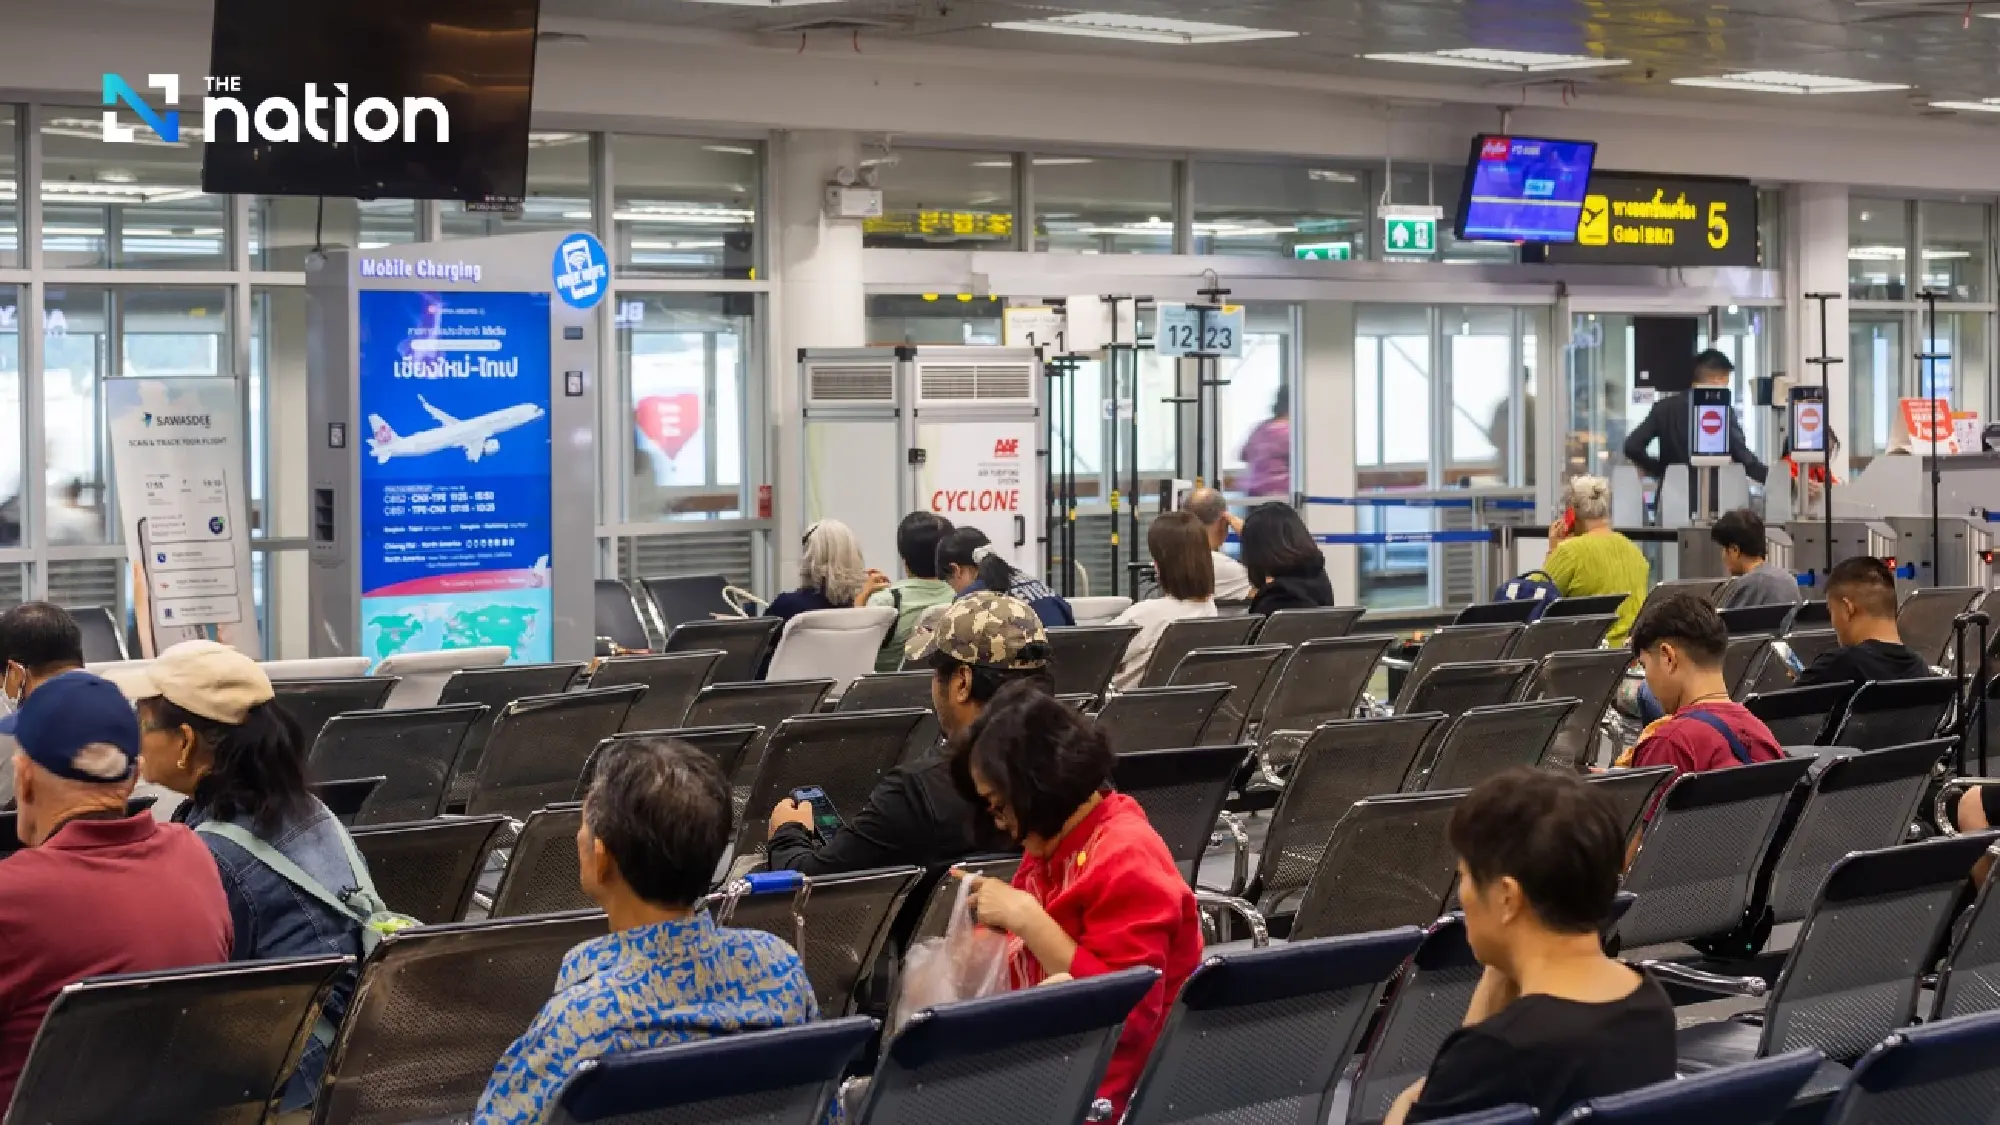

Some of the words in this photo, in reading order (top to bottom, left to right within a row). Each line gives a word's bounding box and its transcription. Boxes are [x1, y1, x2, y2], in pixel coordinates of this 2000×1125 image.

[1707, 201, 1729, 249] 5
[360, 258, 412, 278] Mobile
[415, 259, 482, 283] Charging
[156, 414, 211, 426] SAWASDEE
[931, 489, 1019, 513] CYCLONE
